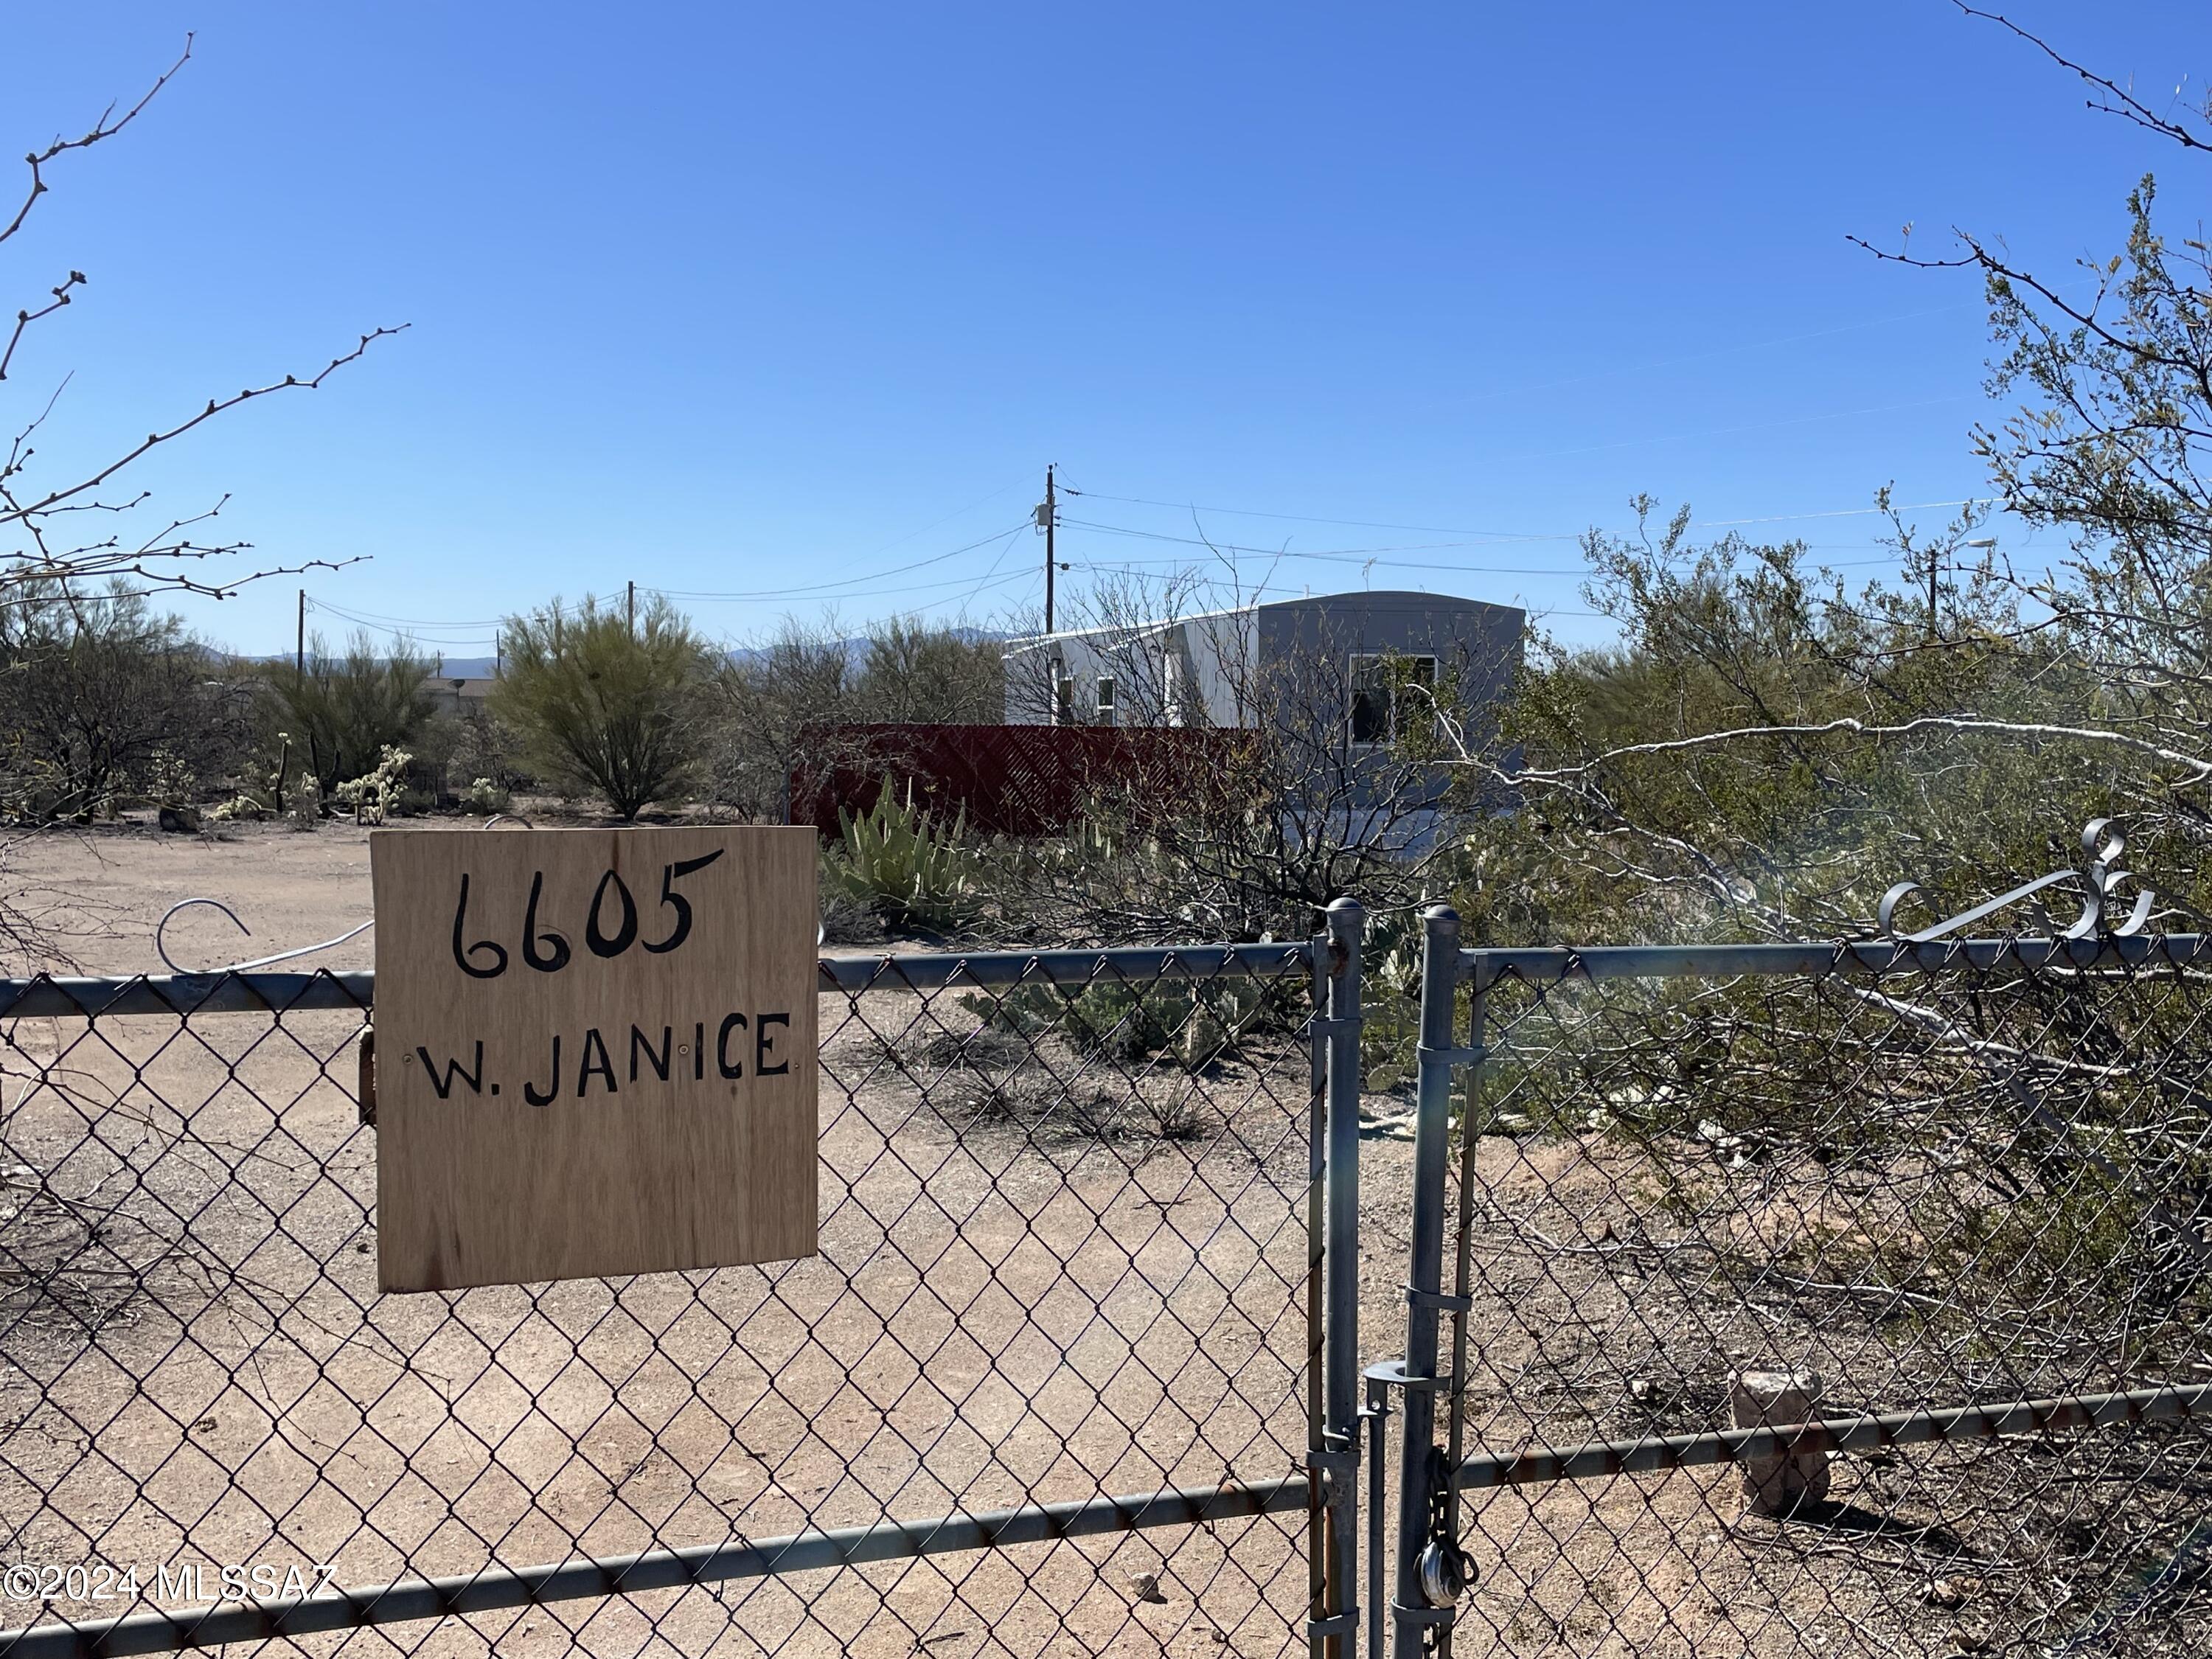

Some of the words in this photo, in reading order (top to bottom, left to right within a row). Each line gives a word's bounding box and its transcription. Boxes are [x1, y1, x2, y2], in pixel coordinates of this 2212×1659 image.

[453, 849, 724, 978] 6605
[417, 1040, 500, 1099] W.
[524, 1012, 790, 1106] JANICE
